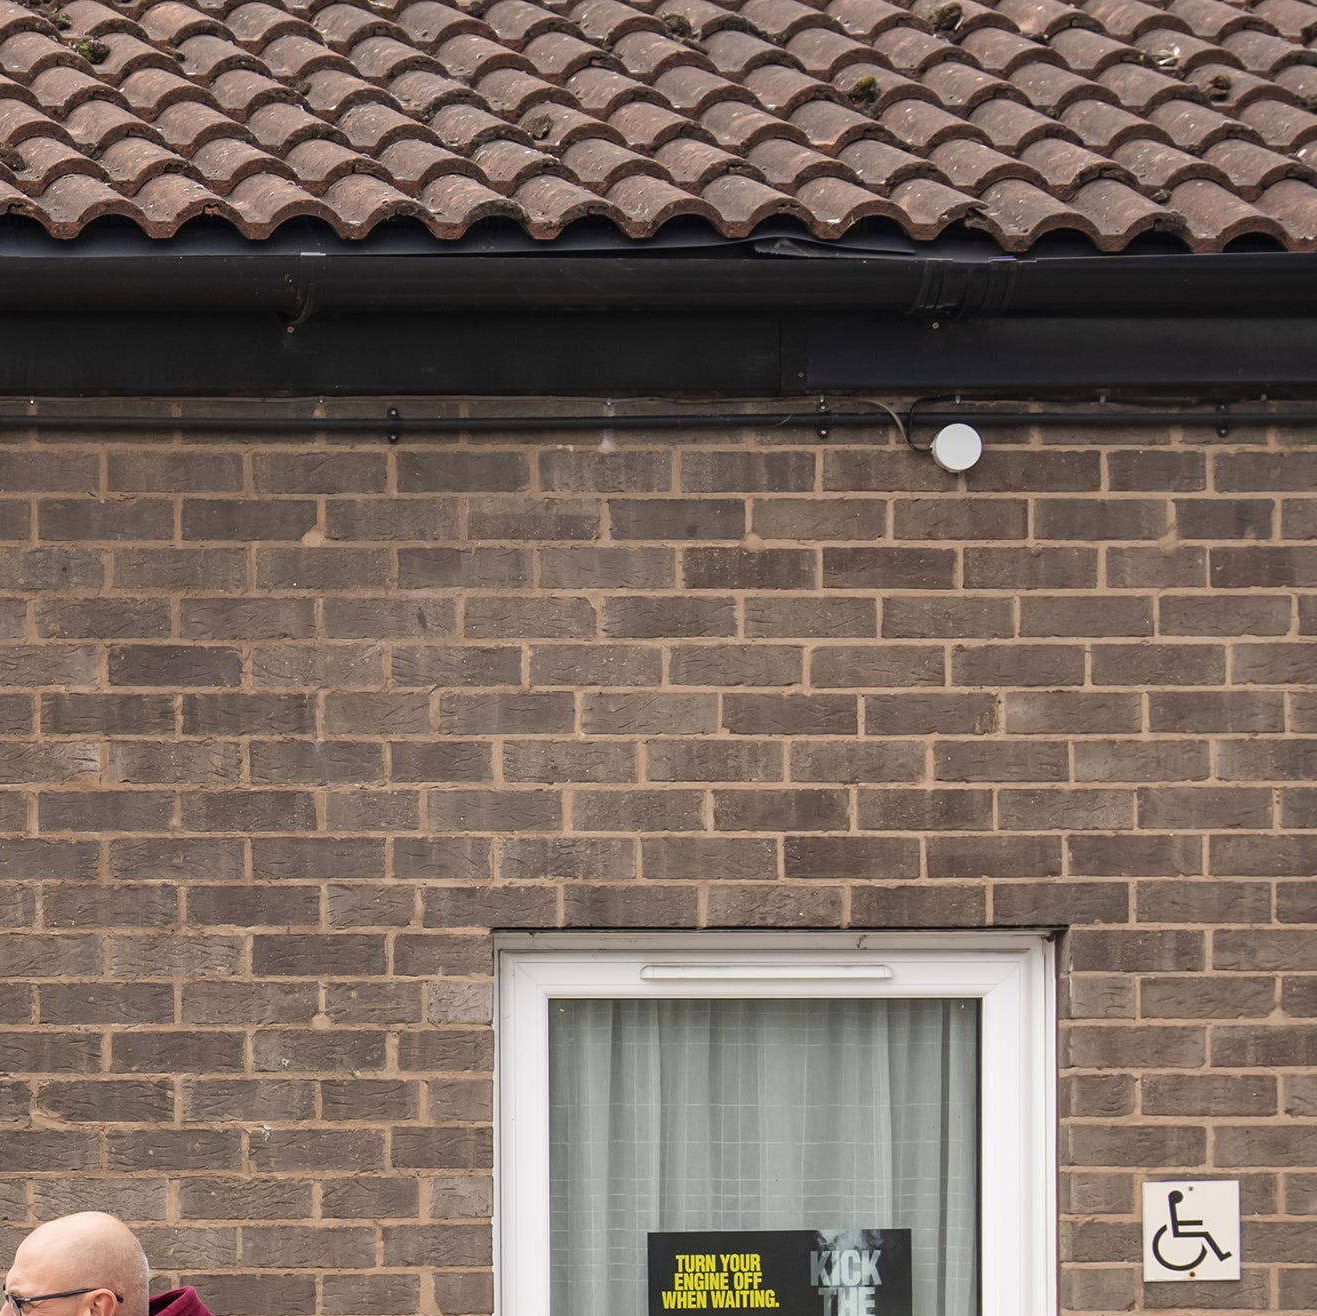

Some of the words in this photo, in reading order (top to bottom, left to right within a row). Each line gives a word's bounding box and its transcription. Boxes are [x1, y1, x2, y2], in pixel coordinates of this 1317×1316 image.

[675, 1254, 716, 1272] TURN
[720, 1253, 761, 1272] YOUR
[810, 1249, 882, 1287] KICK
[674, 1272, 729, 1291] ENGINE
[733, 1271, 763, 1290] OFF
[661, 1291, 707, 1309] WHEN
[711, 1289, 780, 1308] WAITING.
